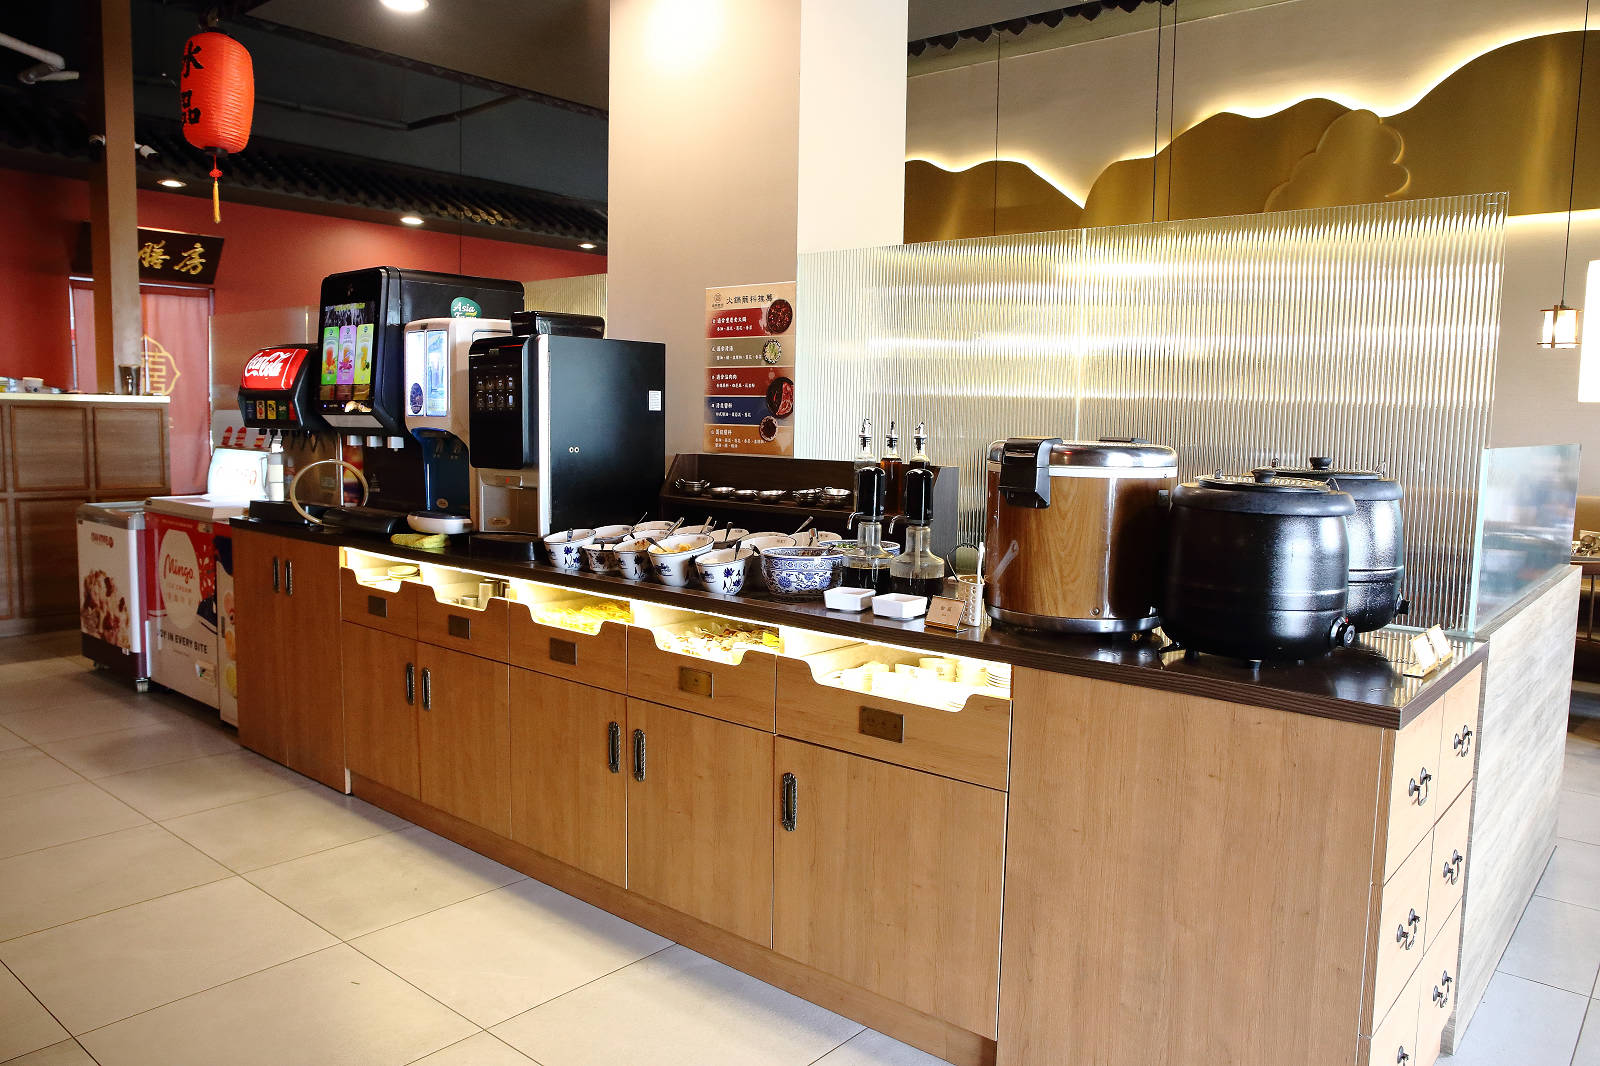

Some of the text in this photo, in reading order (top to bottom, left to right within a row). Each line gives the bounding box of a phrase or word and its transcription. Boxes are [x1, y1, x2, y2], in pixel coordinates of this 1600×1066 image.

[452, 301, 476, 313] Asia
[163, 553, 194, 584] Mingo
[175, 635, 193, 648] EVERY
[194, 641, 208, 654] BITE
